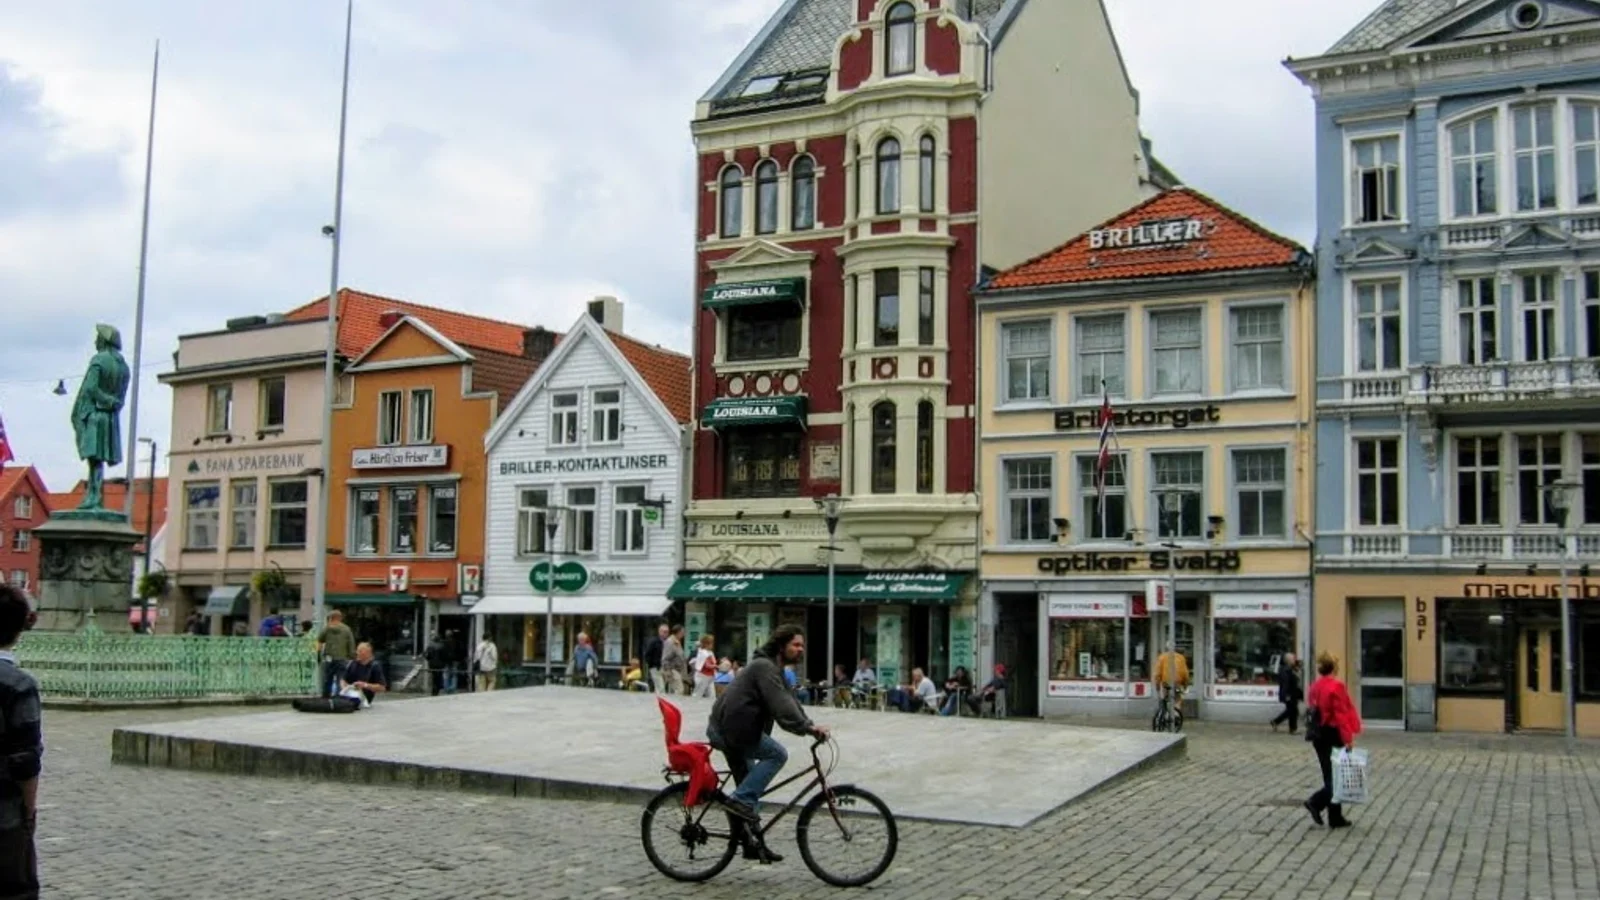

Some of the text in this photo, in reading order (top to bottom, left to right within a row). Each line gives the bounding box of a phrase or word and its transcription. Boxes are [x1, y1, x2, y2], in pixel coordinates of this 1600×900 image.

[1089, 220, 1201, 248] BRILLER
[713, 286, 777, 299] LOUISIANA
[713, 406, 778, 417] LOUISIANA
[1055, 404, 1220, 428] Briletorget
[206, 453, 304, 473] FANA SPAREBANK
[500, 454, 668, 475] BRILLER-KONTAKTLINSER
[711, 524, 780, 536] LOUISIANA
[1037, 552, 1138, 576] optiker
[1416, 597, 1427, 641] bar
